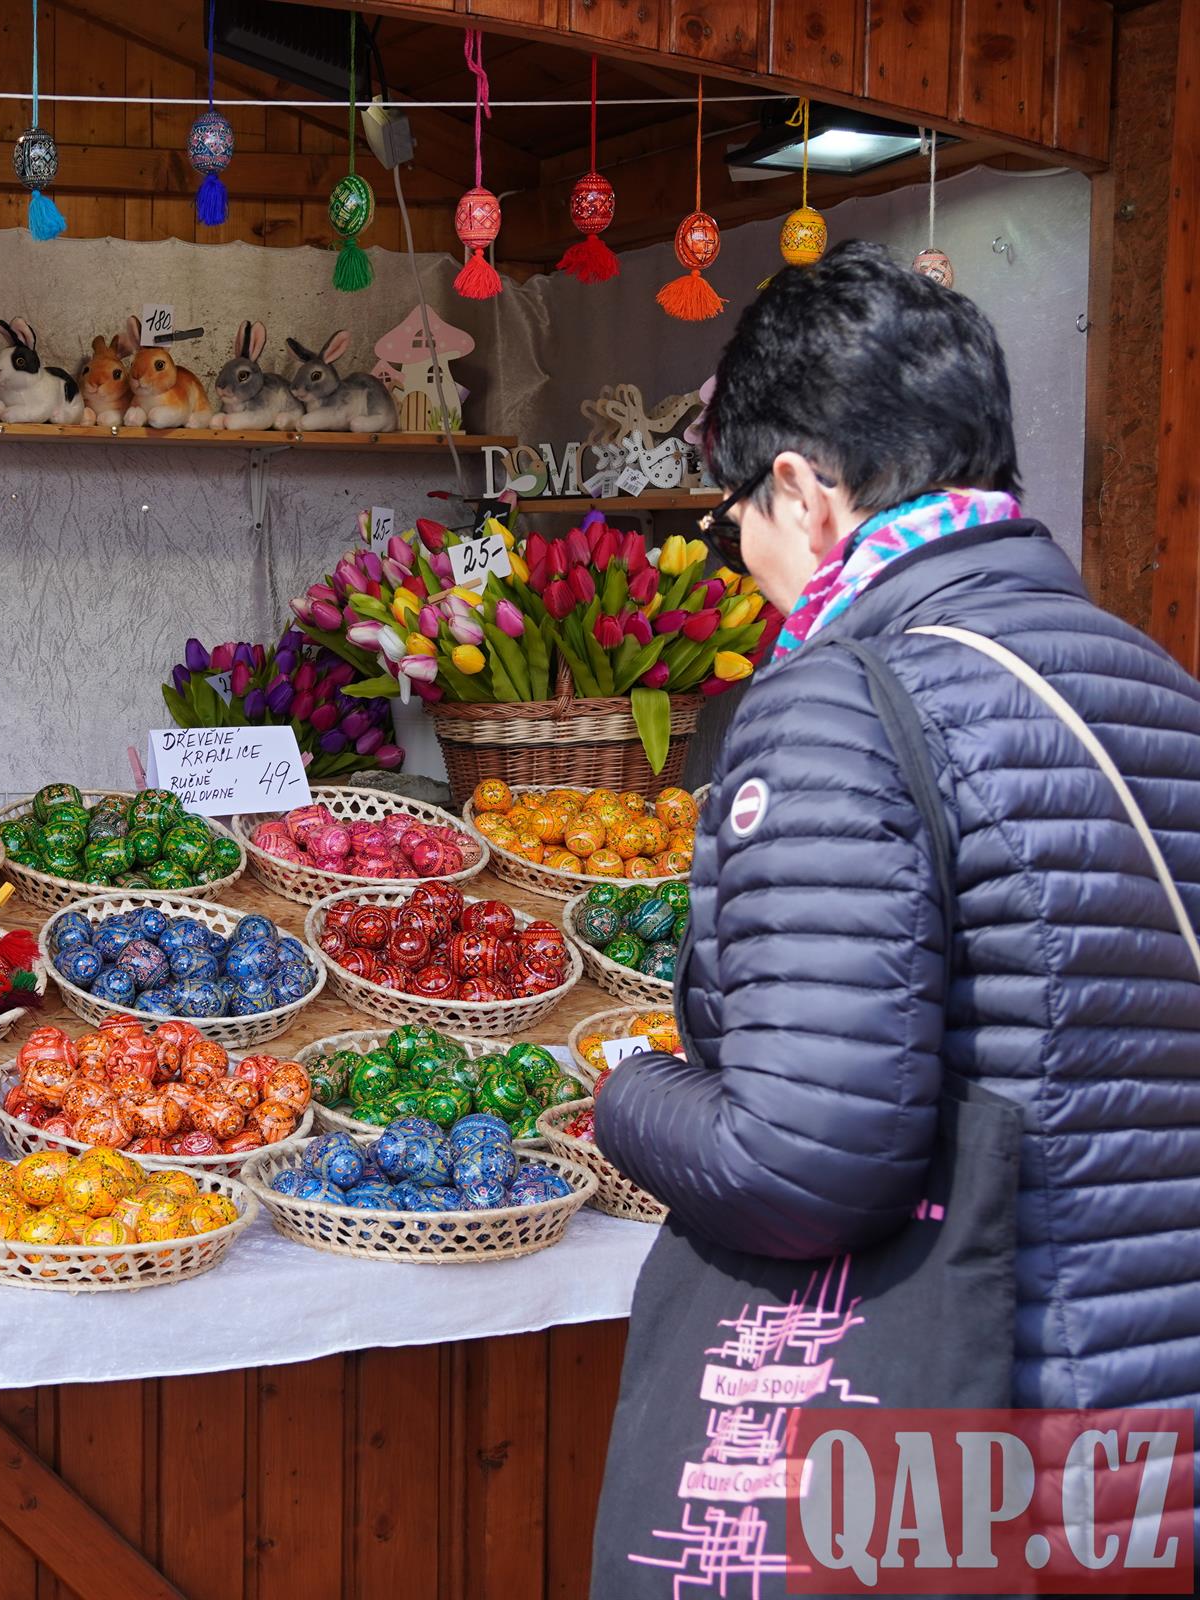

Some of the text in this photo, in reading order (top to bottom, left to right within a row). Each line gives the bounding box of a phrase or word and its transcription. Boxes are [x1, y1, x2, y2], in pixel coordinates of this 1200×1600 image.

[163, 728, 240, 750] DŘEVĚNÉ
[181, 744, 264, 767] KRASLICE
[170, 768, 213, 791] RUČNĚ
